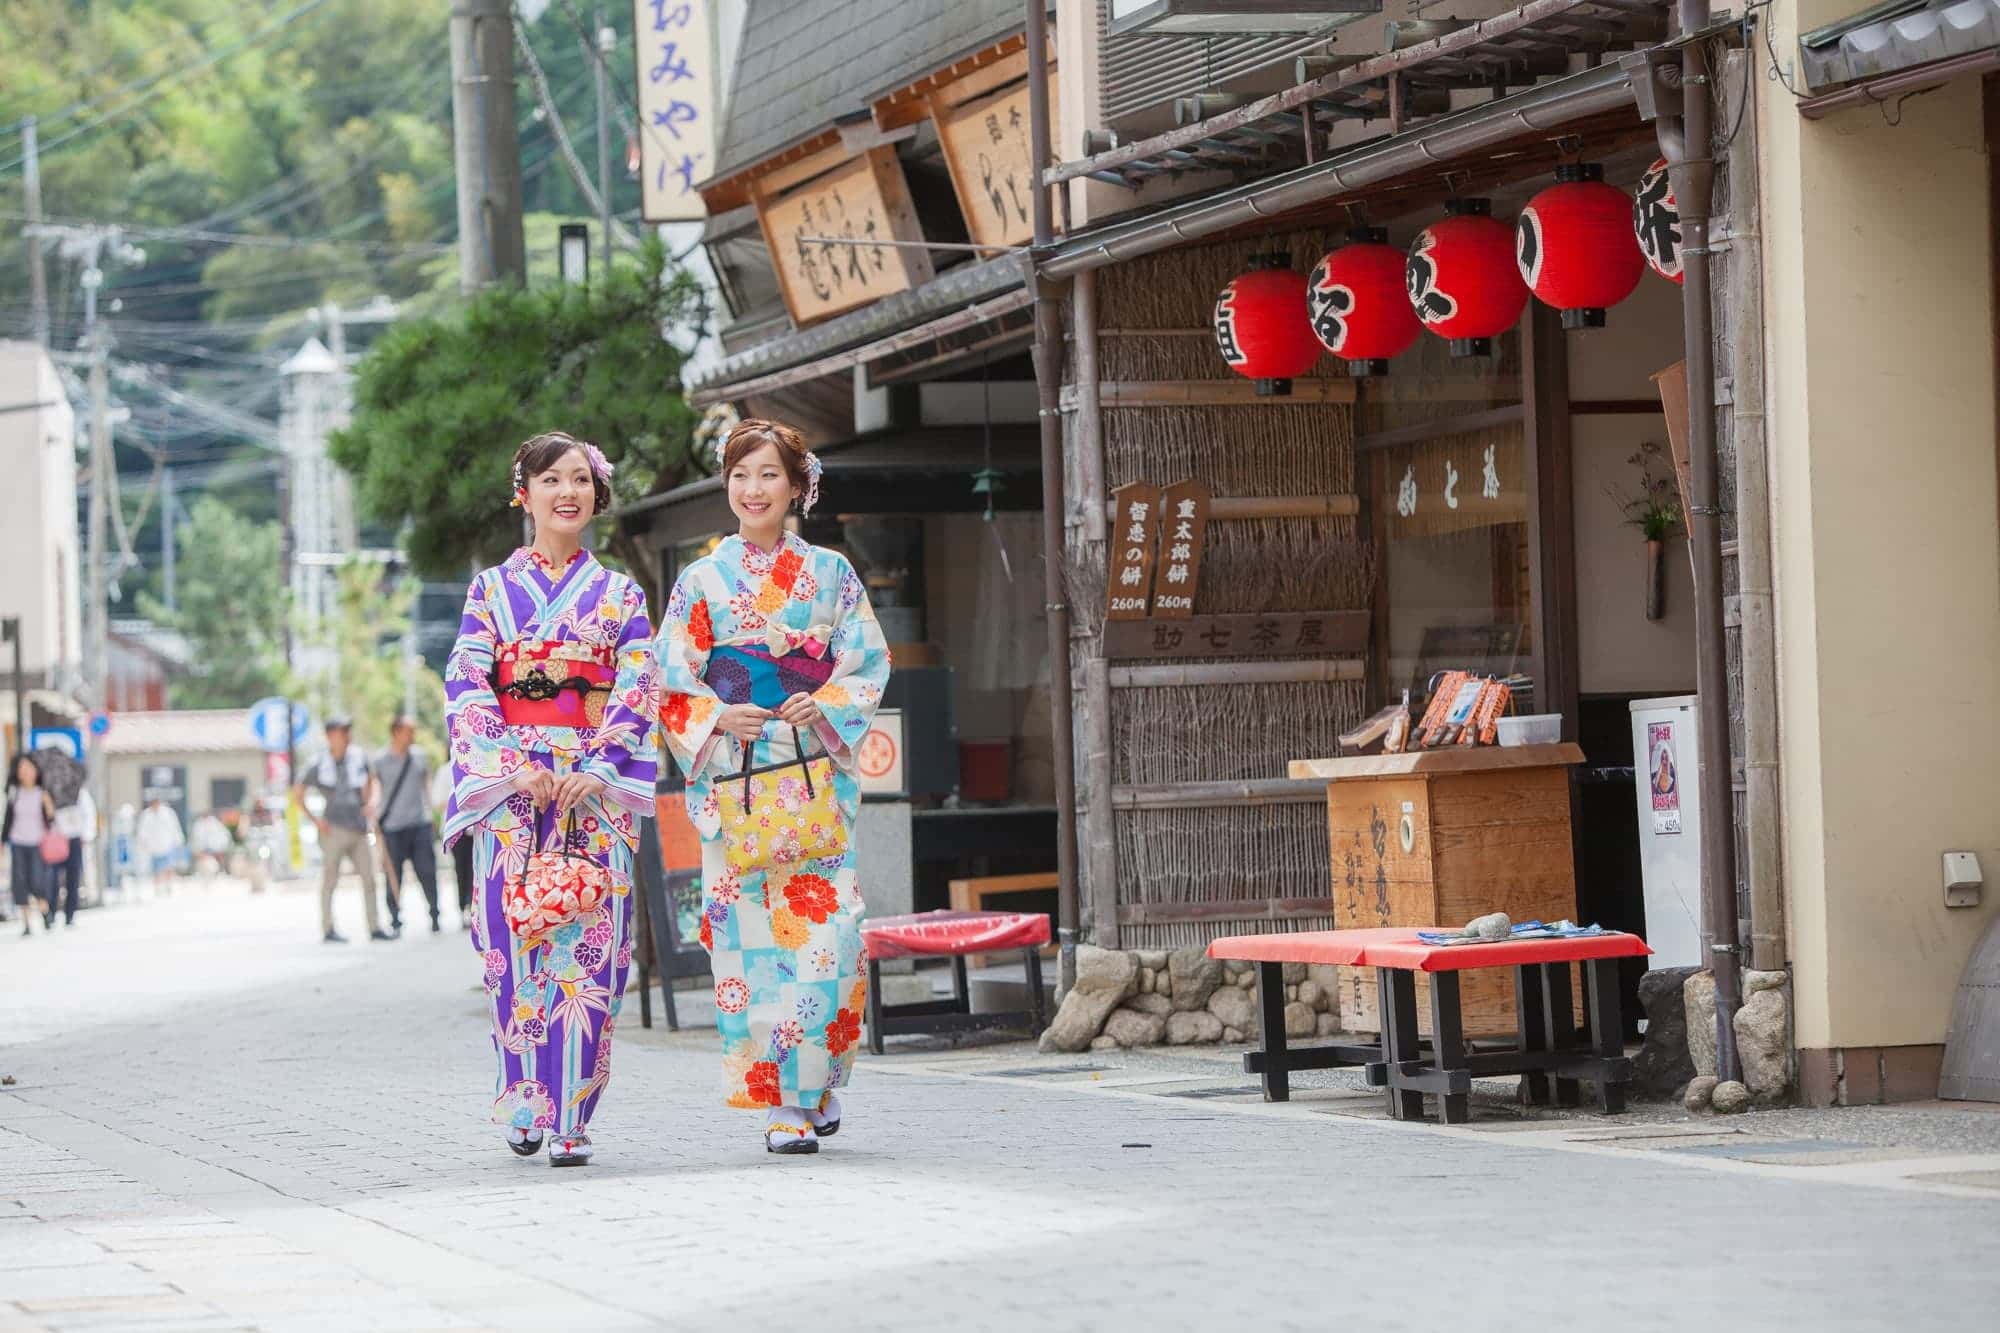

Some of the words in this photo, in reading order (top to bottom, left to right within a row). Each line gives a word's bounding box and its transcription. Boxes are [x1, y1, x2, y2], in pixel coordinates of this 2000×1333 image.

[1119, 500, 1150, 586] 智恵の餅
[1111, 597, 1146, 610] 260円
[1156, 595, 1192, 609] 260円
